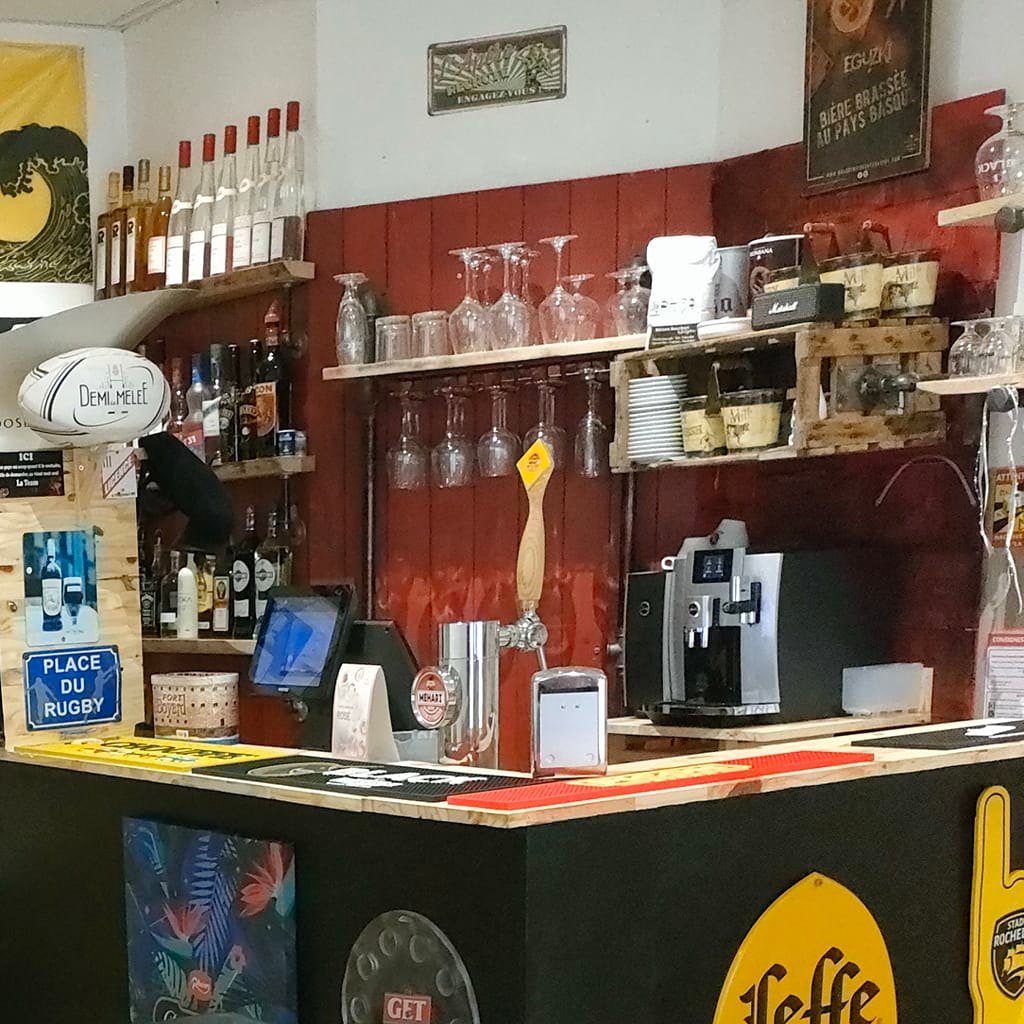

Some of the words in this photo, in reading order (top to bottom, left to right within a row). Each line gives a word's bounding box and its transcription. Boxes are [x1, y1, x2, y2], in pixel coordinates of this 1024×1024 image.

[819, 99, 852, 128] BIÈRE
[855, 69, 908, 110] BRASSÉE
[817, 127, 831, 148] AU
[836, 110, 866, 140] PAYS
[79, 384, 110, 407] DEMI
[18, 452, 34, 462] ICI
[43, 655, 102, 675] PLACE
[60, 678, 85, 695] DU
[44, 697, 105, 718] RUGBY
[387, 997, 427, 1021] GET
